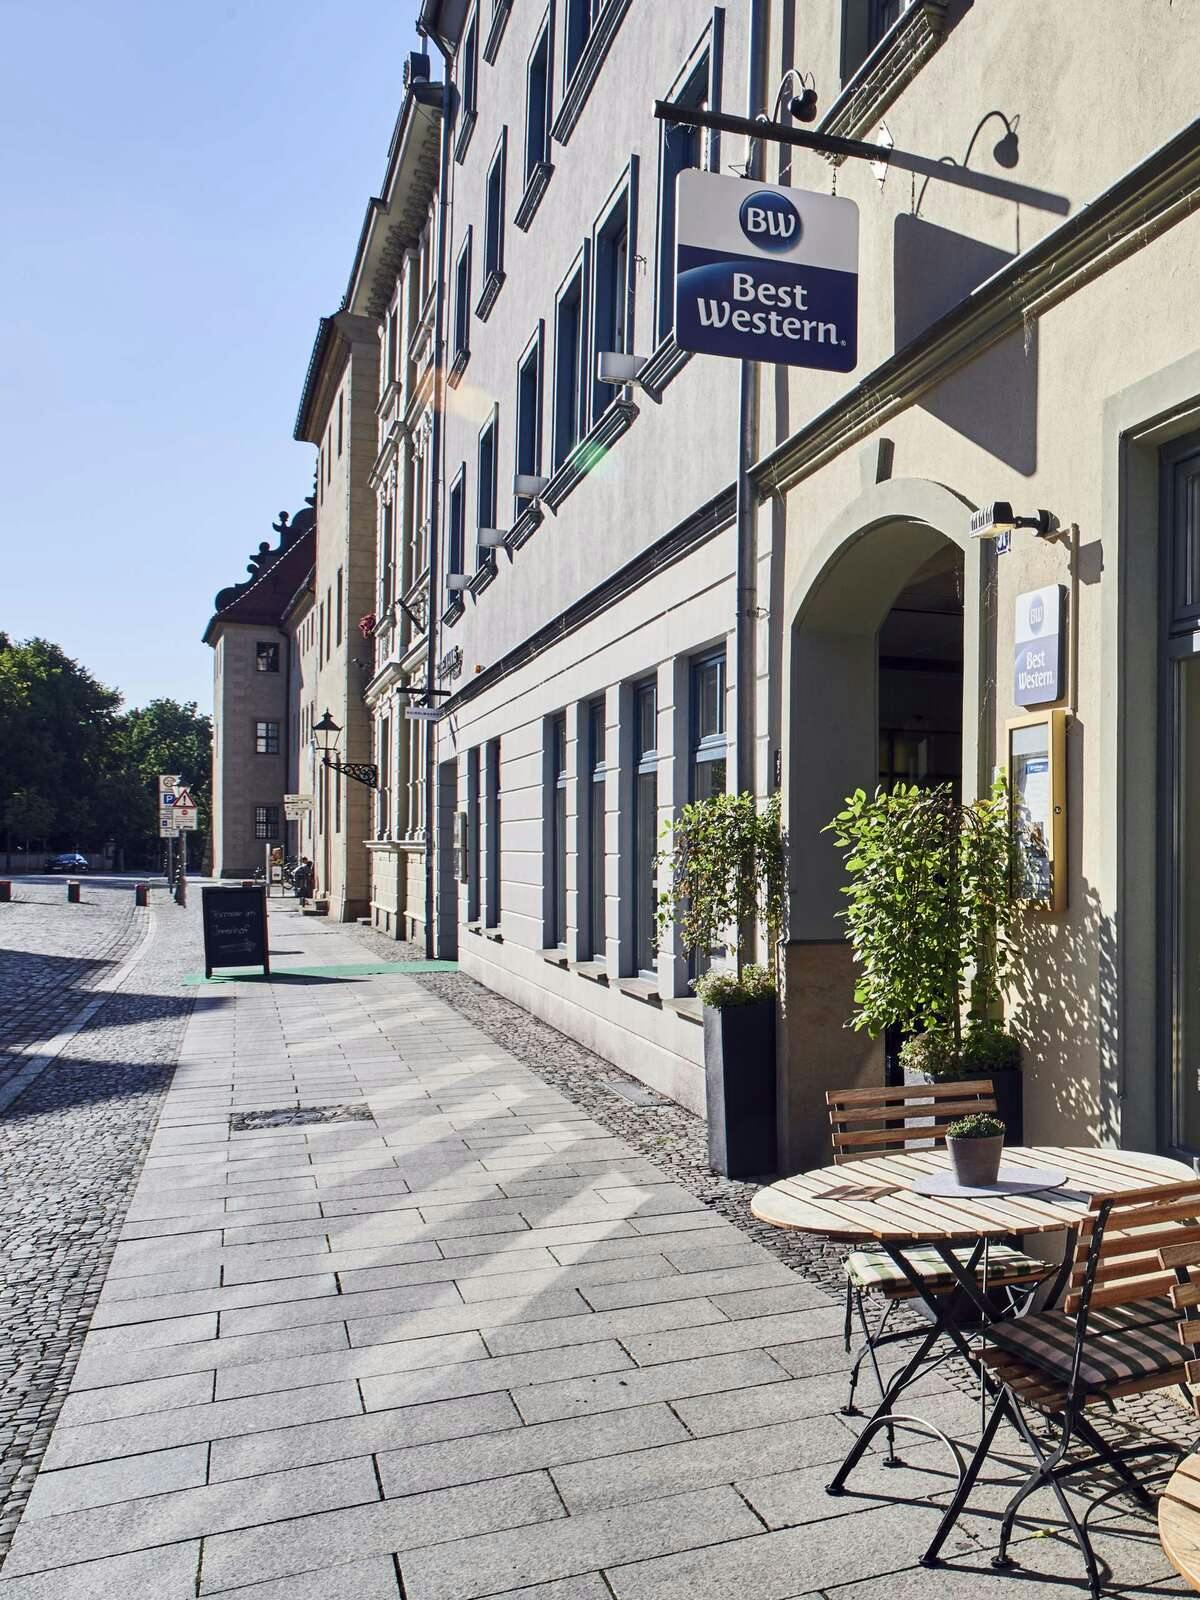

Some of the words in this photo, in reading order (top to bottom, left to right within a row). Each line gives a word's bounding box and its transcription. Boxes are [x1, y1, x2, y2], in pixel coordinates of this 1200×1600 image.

[746, 207, 796, 238] BW
[732, 272, 809, 311] Best
[1026, 650, 1046, 670] Best
